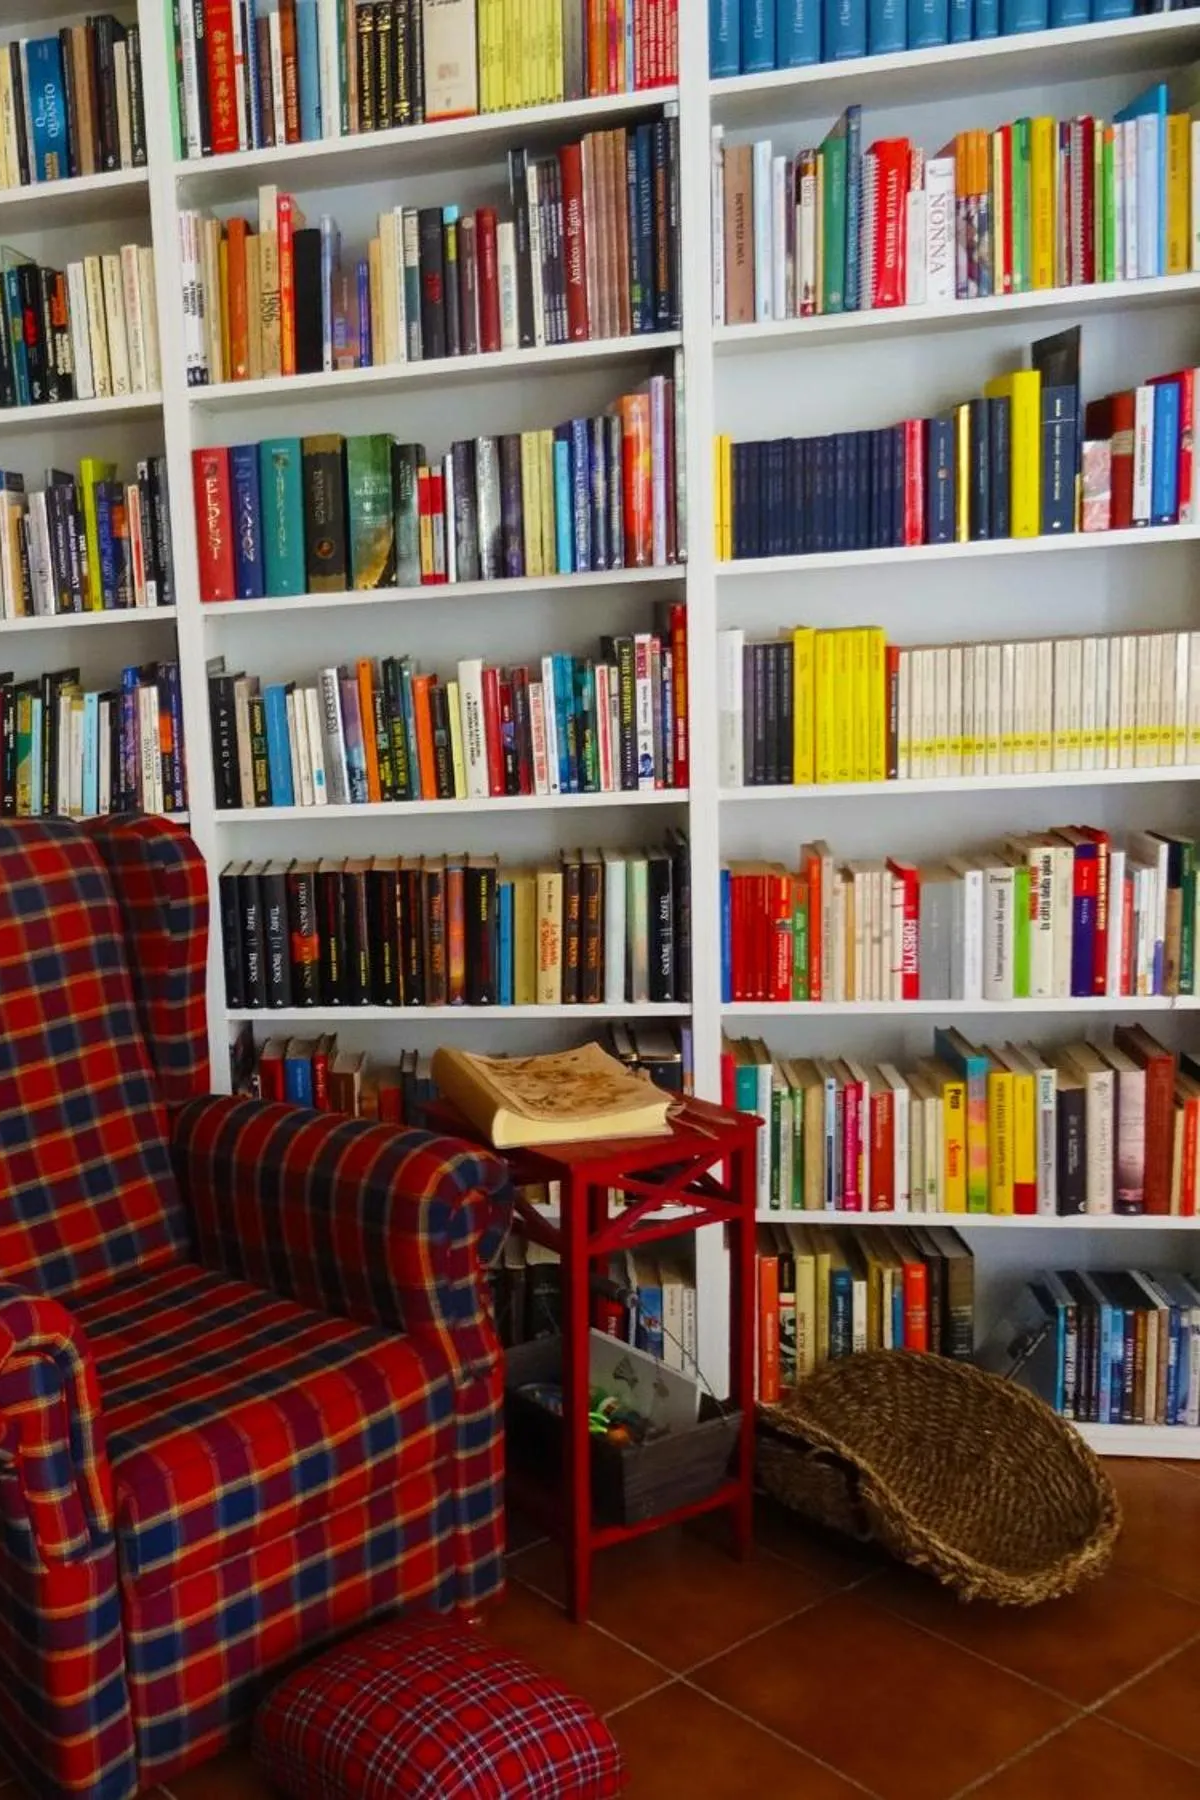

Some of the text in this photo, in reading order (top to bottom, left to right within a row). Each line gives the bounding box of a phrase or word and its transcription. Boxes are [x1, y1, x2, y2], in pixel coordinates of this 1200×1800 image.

[566, 198, 582, 285] Antico Egitto
[885, 168, 897, 268] OSTERIE D'ITALIA
[928, 192, 946, 275] NONNA
[1041, 878, 1052, 899] della
[903, 918, 917, 974] FORSYTH
